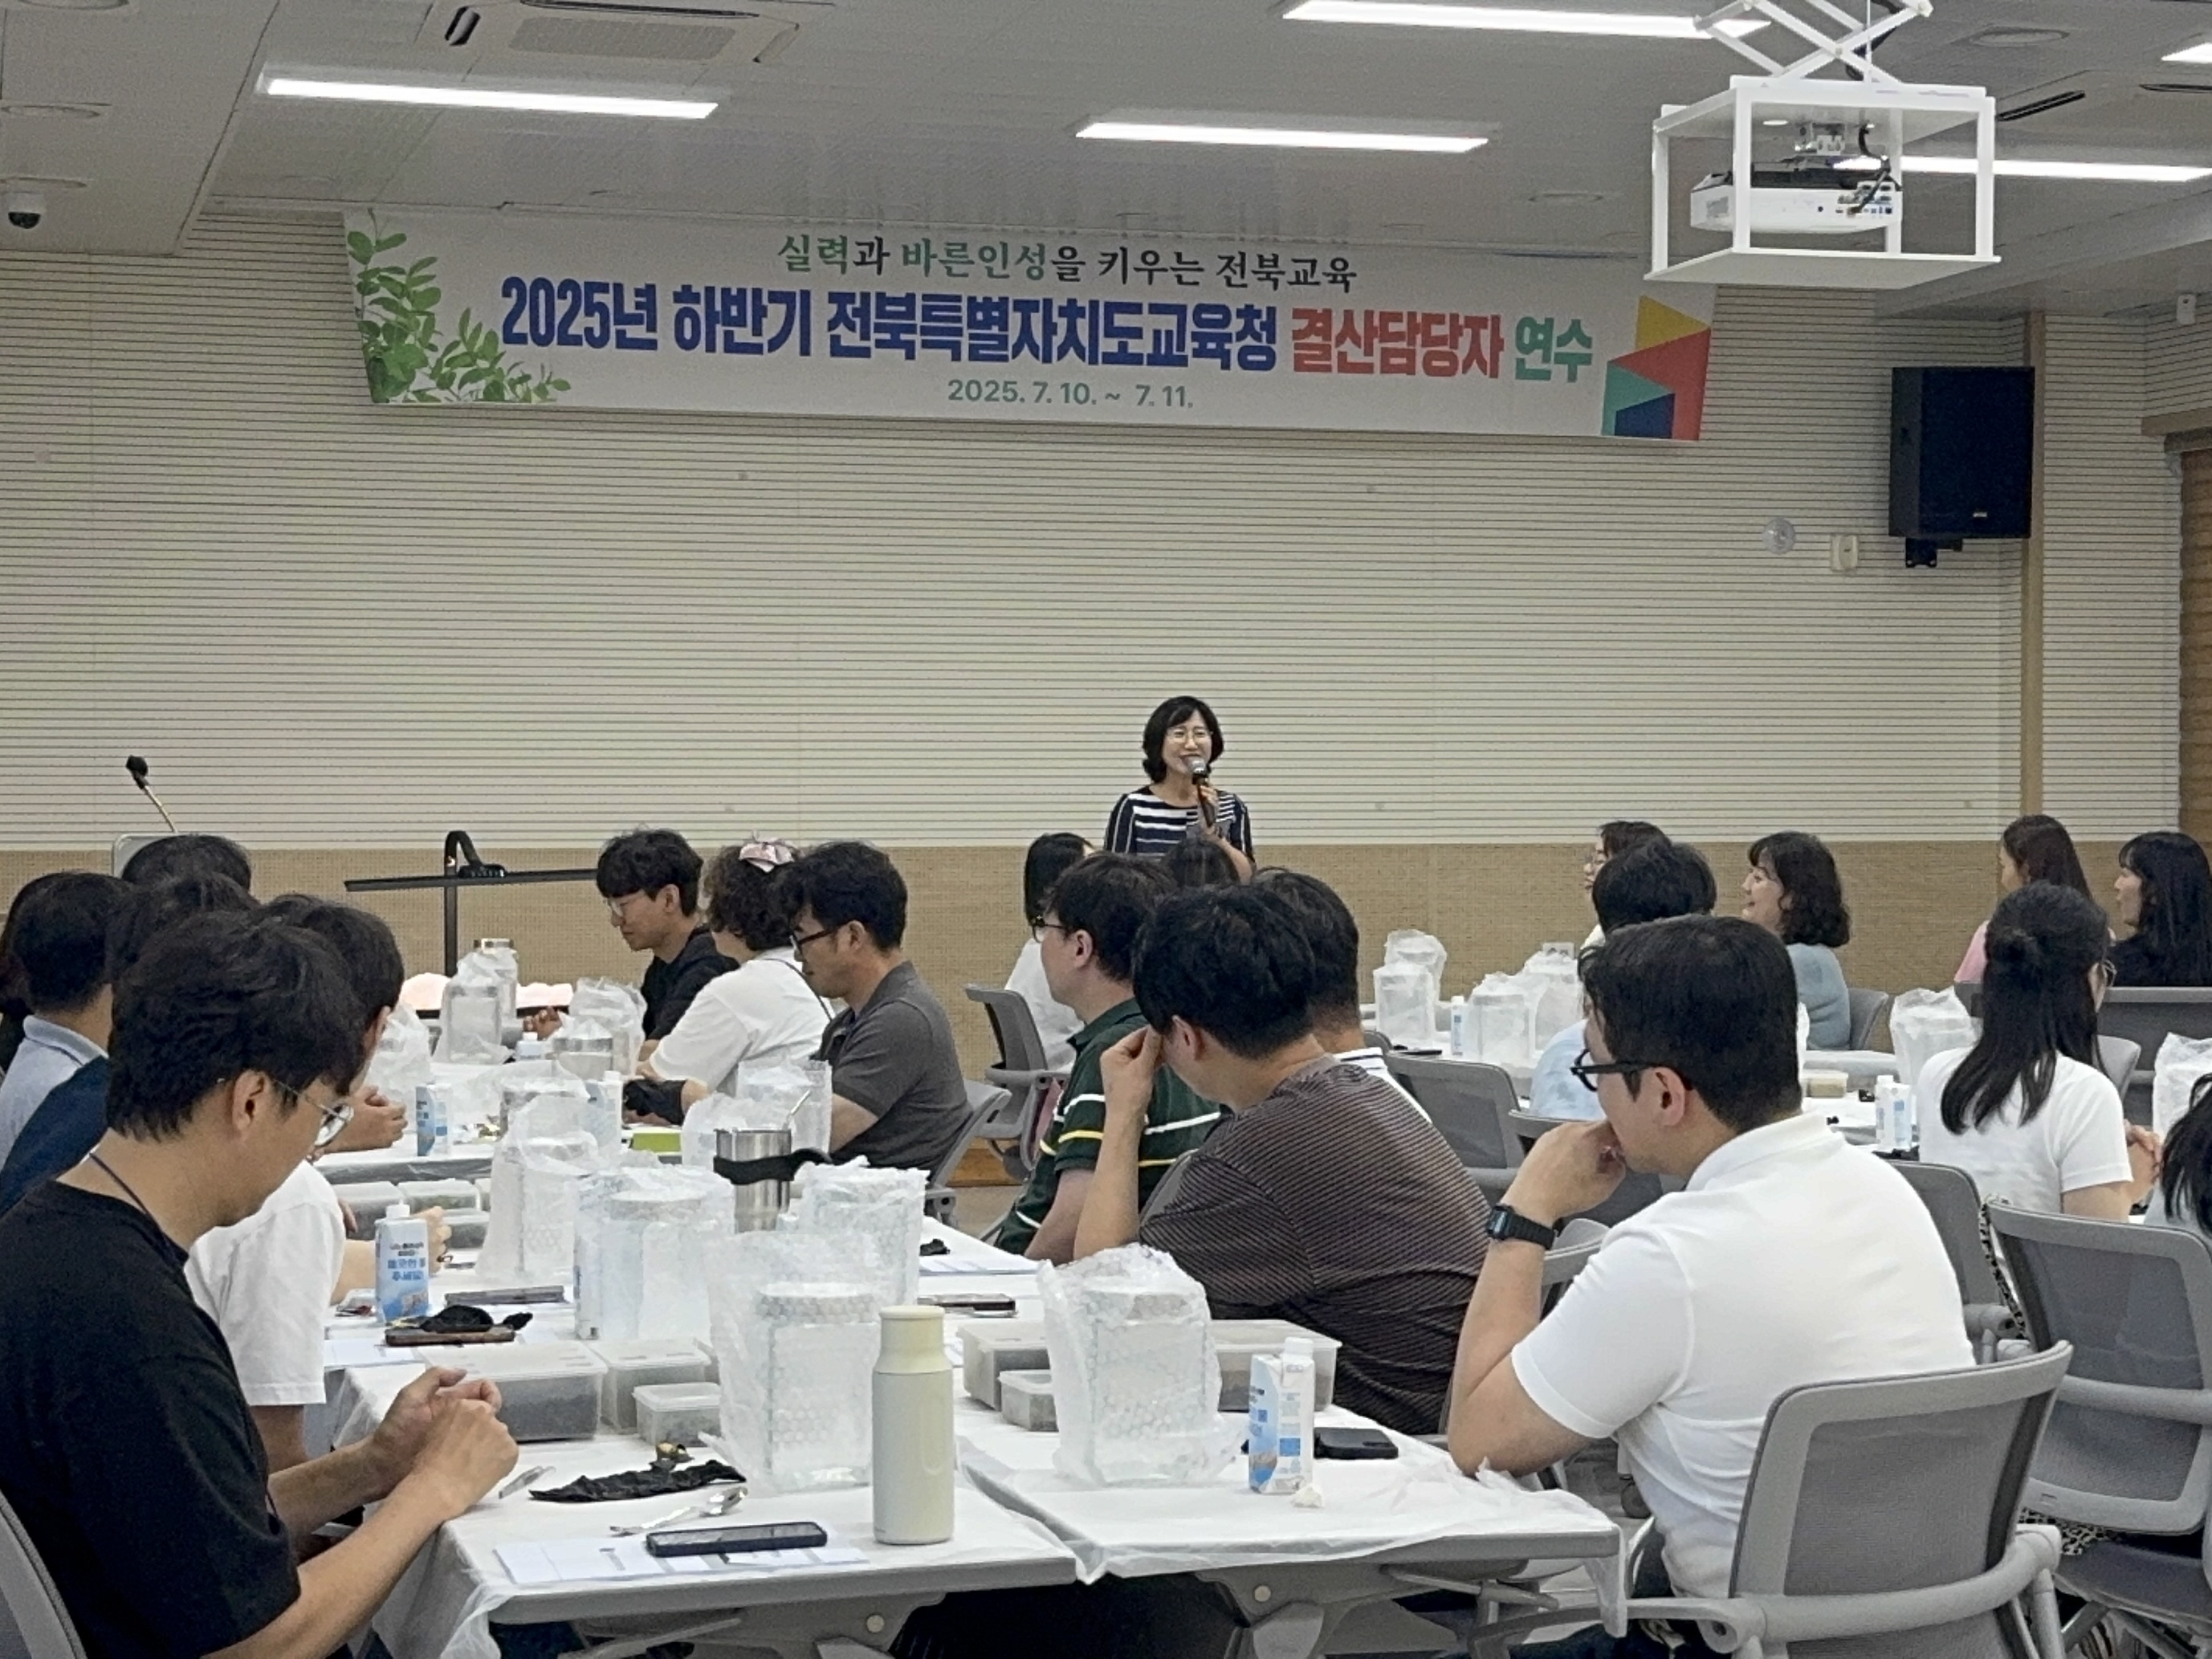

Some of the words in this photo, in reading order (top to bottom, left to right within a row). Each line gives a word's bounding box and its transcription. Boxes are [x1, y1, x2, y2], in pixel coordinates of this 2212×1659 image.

[777, 234, 891, 276] 실력과
[901, 238, 1086, 283] 바른인성을
[1098, 246, 1205, 286] 키우는
[1216, 251, 1359, 294] 전북교육
[499, 275, 658, 350] 2025년
[673, 283, 813, 357] 하반기
[826, 290, 1278, 373] 전북특별자치도교육청
[1290, 307, 1504, 380] 결산담당자
[1513, 316, 1595, 383] 연수
